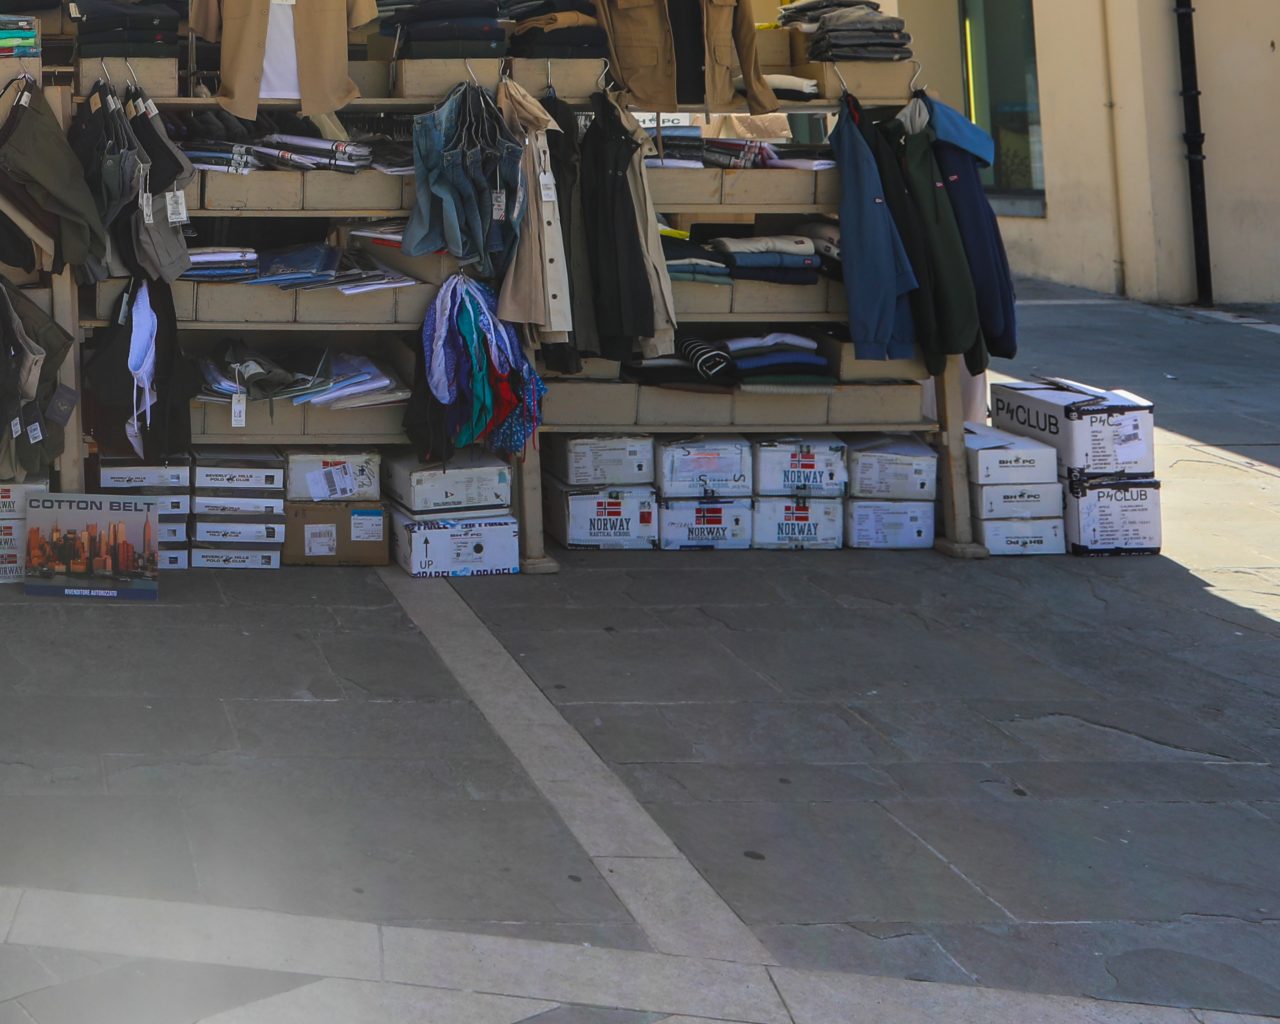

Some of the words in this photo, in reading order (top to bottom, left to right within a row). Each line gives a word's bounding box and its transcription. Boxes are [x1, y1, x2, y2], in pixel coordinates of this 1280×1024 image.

[783, 470, 824, 483] NORWAY
[29, 498, 103, 511] COTTON
[109, 501, 155, 513] BELT
[589, 518, 631, 531] NORWAY
[777, 523, 818, 535] NORWAY
[688, 527, 727, 536] NORWAY
[419, 559, 434, 569] UP
